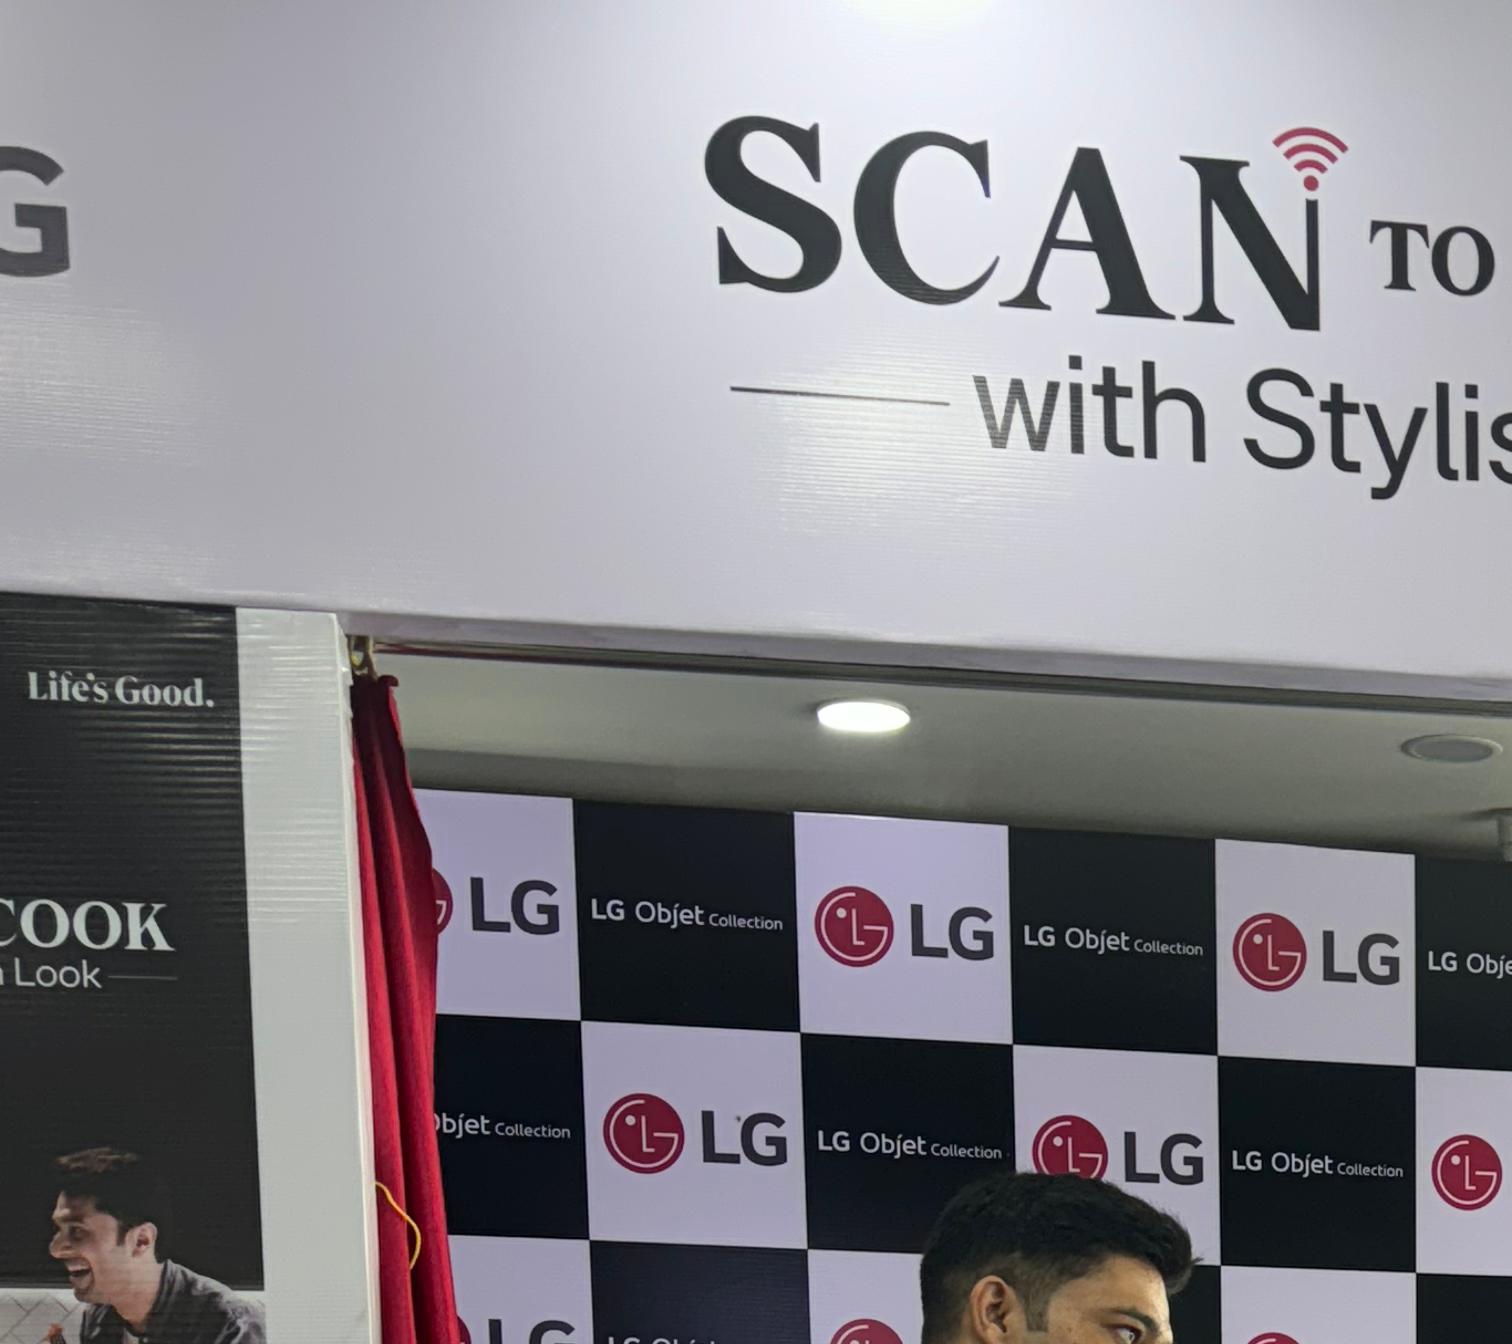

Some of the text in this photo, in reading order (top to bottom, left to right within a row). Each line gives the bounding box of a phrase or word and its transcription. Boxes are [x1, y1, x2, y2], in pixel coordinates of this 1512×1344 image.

[703, 115, 1320, 333] SCAN
[1370, 220, 1495, 296] TO
[974, 355, 1203, 463] with
[29, 671, 214, 707] Life's Good.
[470, 877, 559, 935] LG
[592, 899, 624, 920] LG
[709, 914, 782, 930] Collection
[911, 904, 994, 960] LG
[15, 958, 101, 988] Look
[1323, 930, 1399, 985] LG
[495, 1123, 570, 1138] Collection
[702, 1110, 787, 1166] LG
[1124, 1132, 1203, 1185] LG
[1233, 1150, 1262, 1170] LG
[1337, 1162, 1403, 1177] Collection
